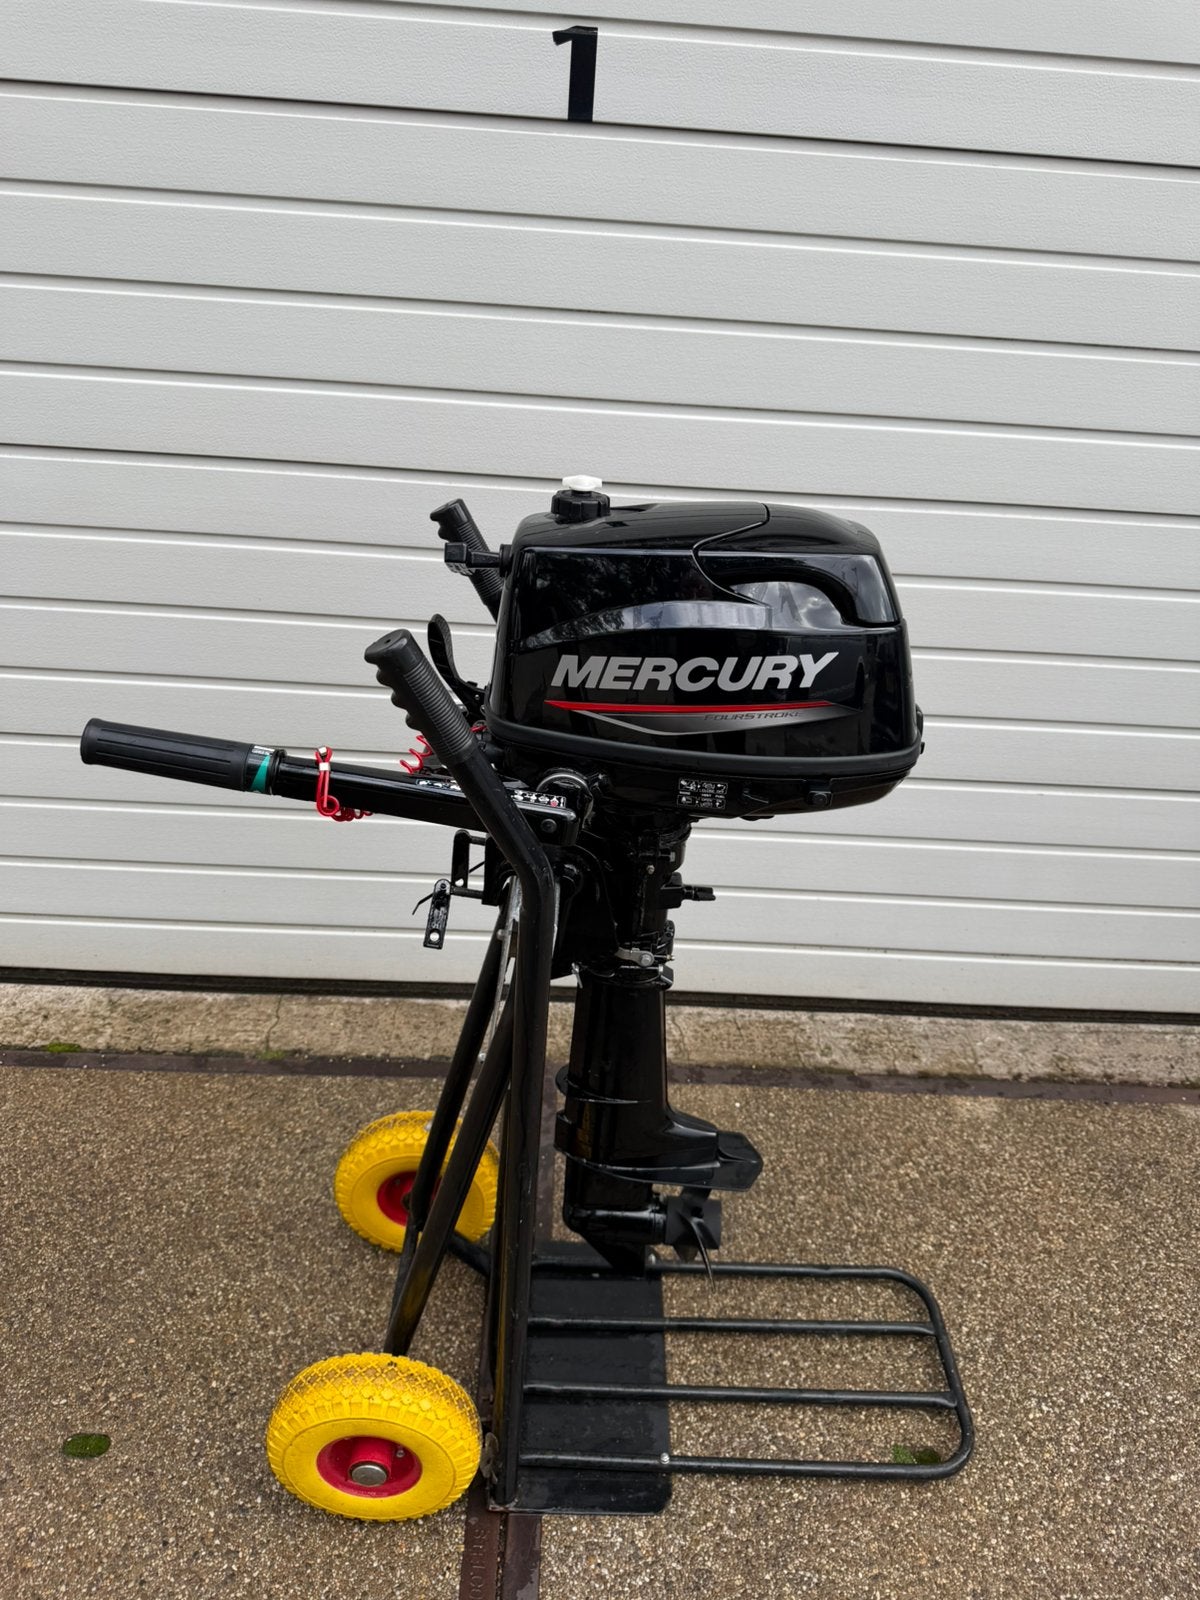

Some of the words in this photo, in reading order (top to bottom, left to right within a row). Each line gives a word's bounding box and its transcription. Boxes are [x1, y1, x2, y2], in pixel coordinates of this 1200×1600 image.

[552, 25, 598, 122] 1
[551, 652, 839, 691] MERCURY
[704, 711, 802, 721] FOURSTROKE
